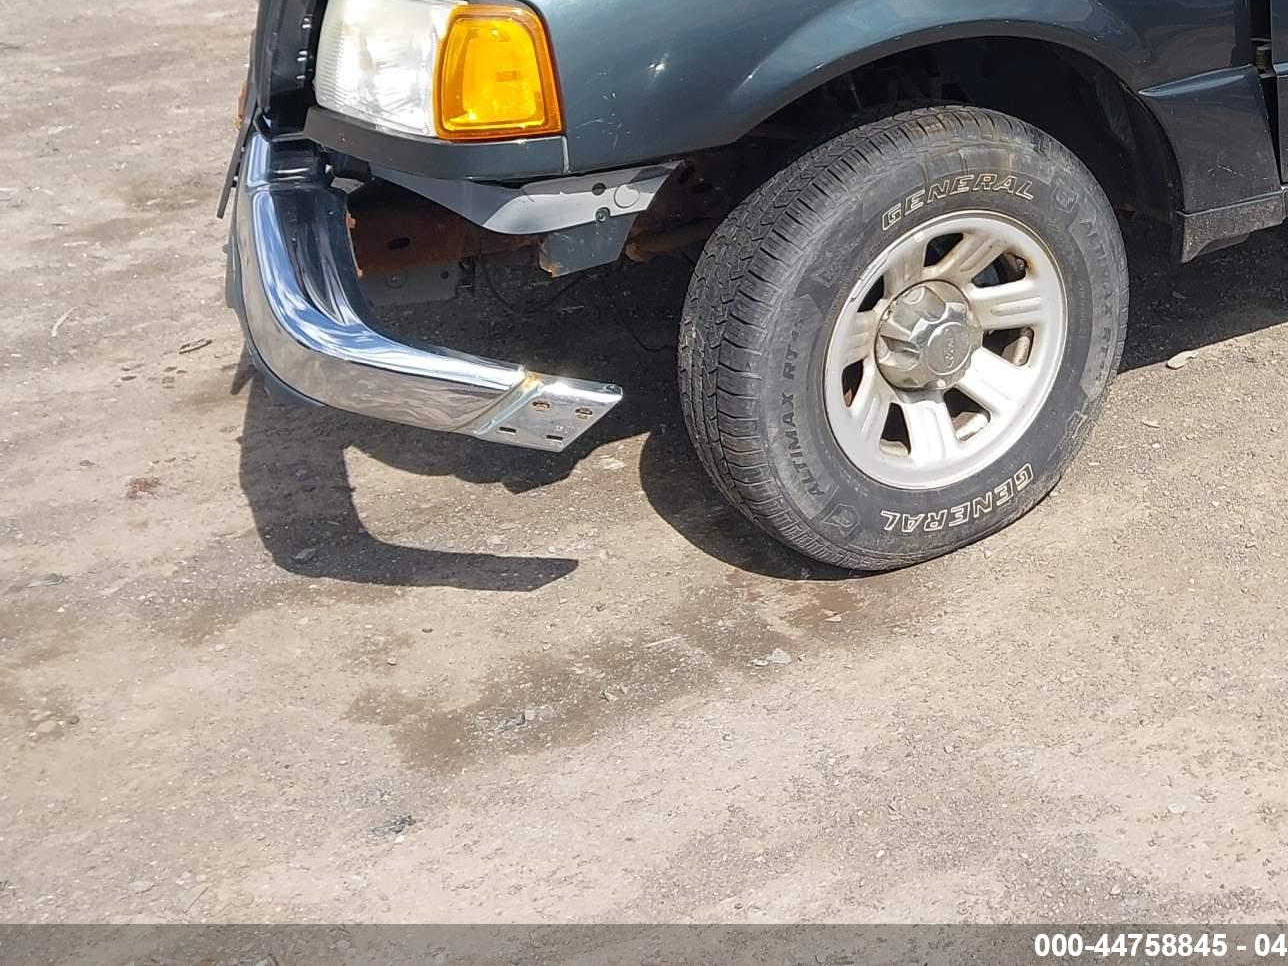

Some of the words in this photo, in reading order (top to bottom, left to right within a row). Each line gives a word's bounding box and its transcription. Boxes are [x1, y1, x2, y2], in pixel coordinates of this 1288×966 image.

[881, 172, 1035, 232] GENERAL
[781, 392, 826, 497] ALTIMAX
[880, 462, 1034, 533] GENERAL
